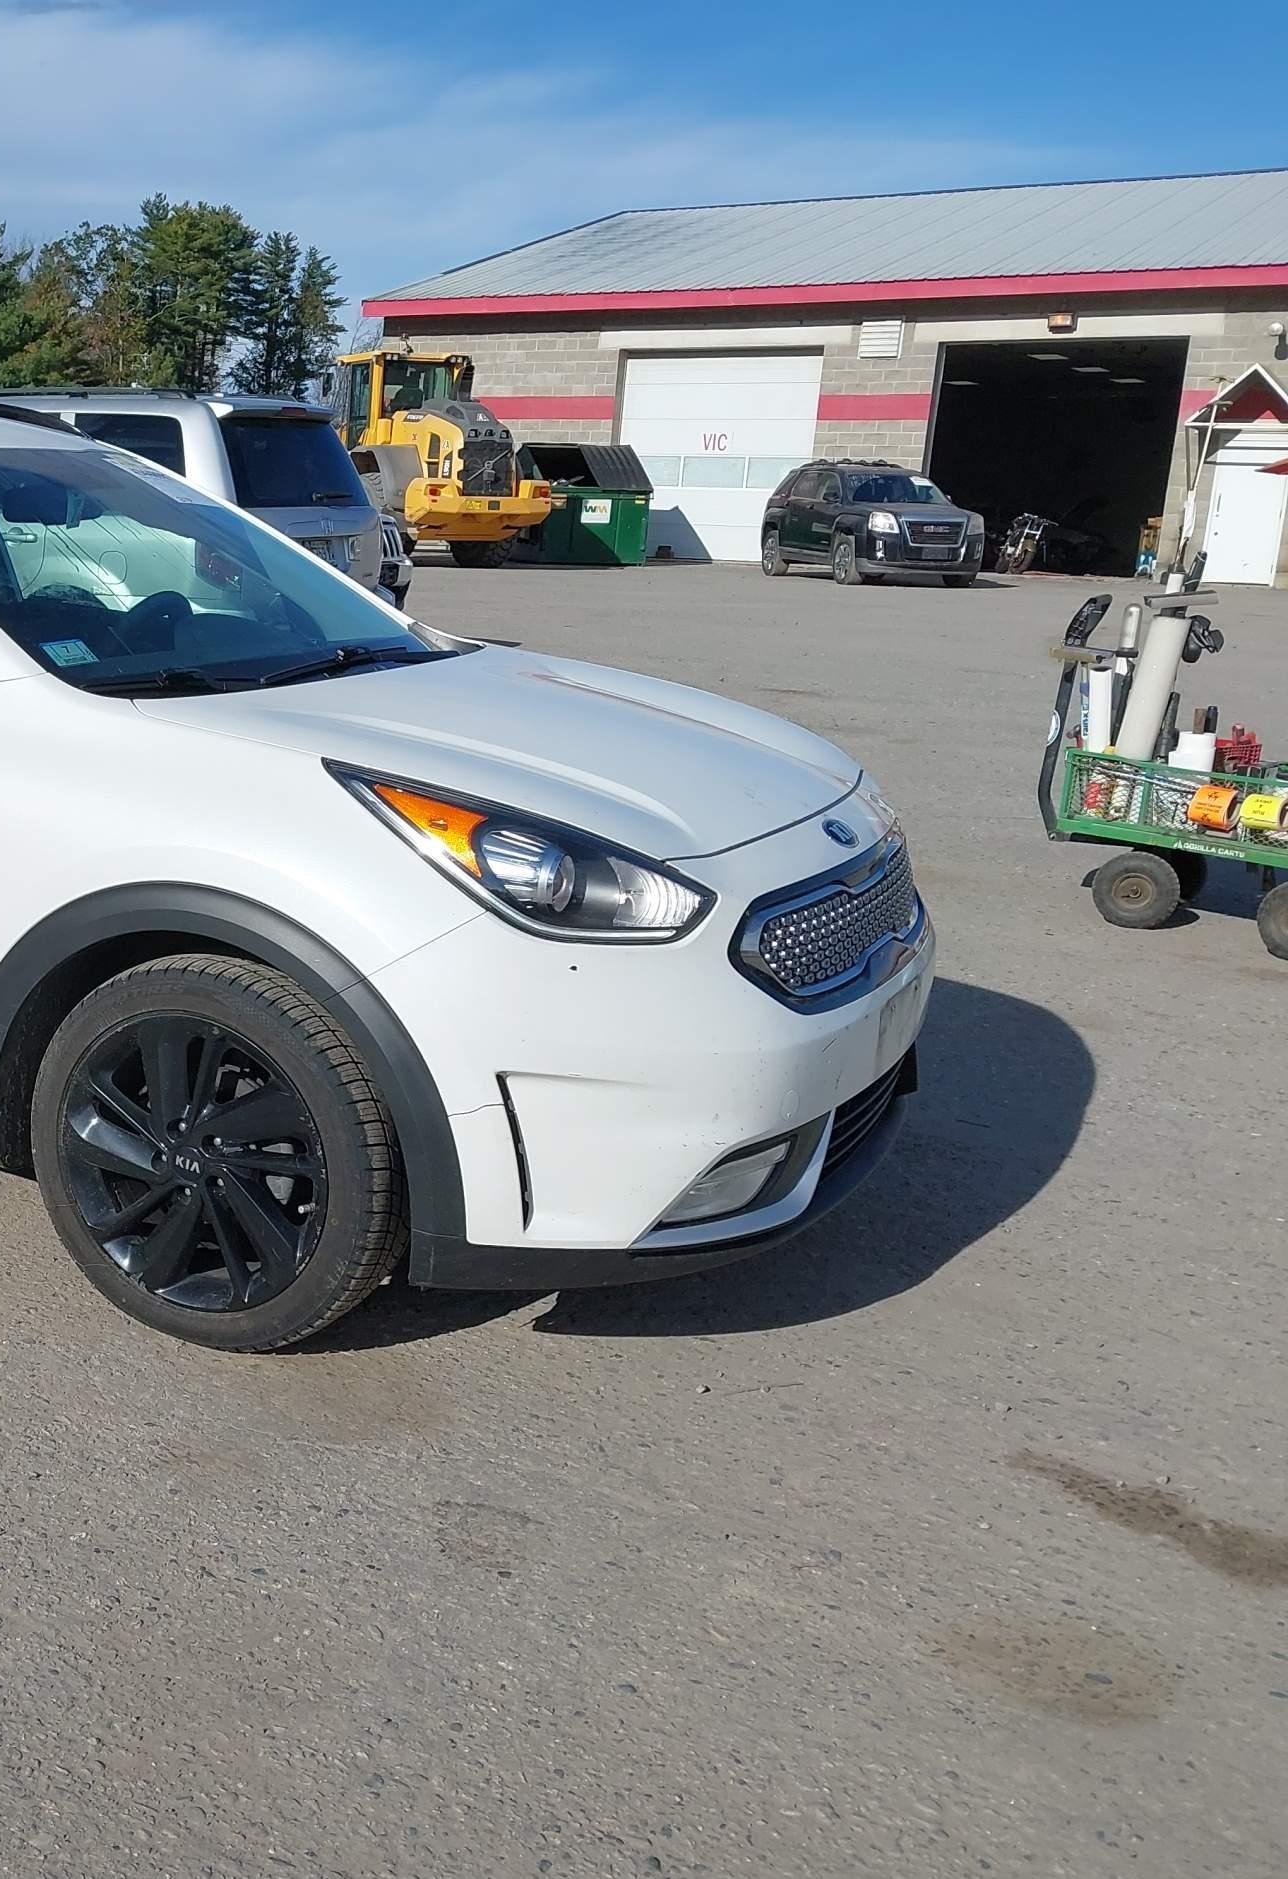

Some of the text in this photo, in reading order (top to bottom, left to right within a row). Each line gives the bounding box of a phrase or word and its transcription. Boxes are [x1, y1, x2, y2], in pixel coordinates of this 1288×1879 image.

[703, 433, 728, 452] VIC
[584, 505, 608, 513] WM
[175, 1154, 201, 1174] KIA
